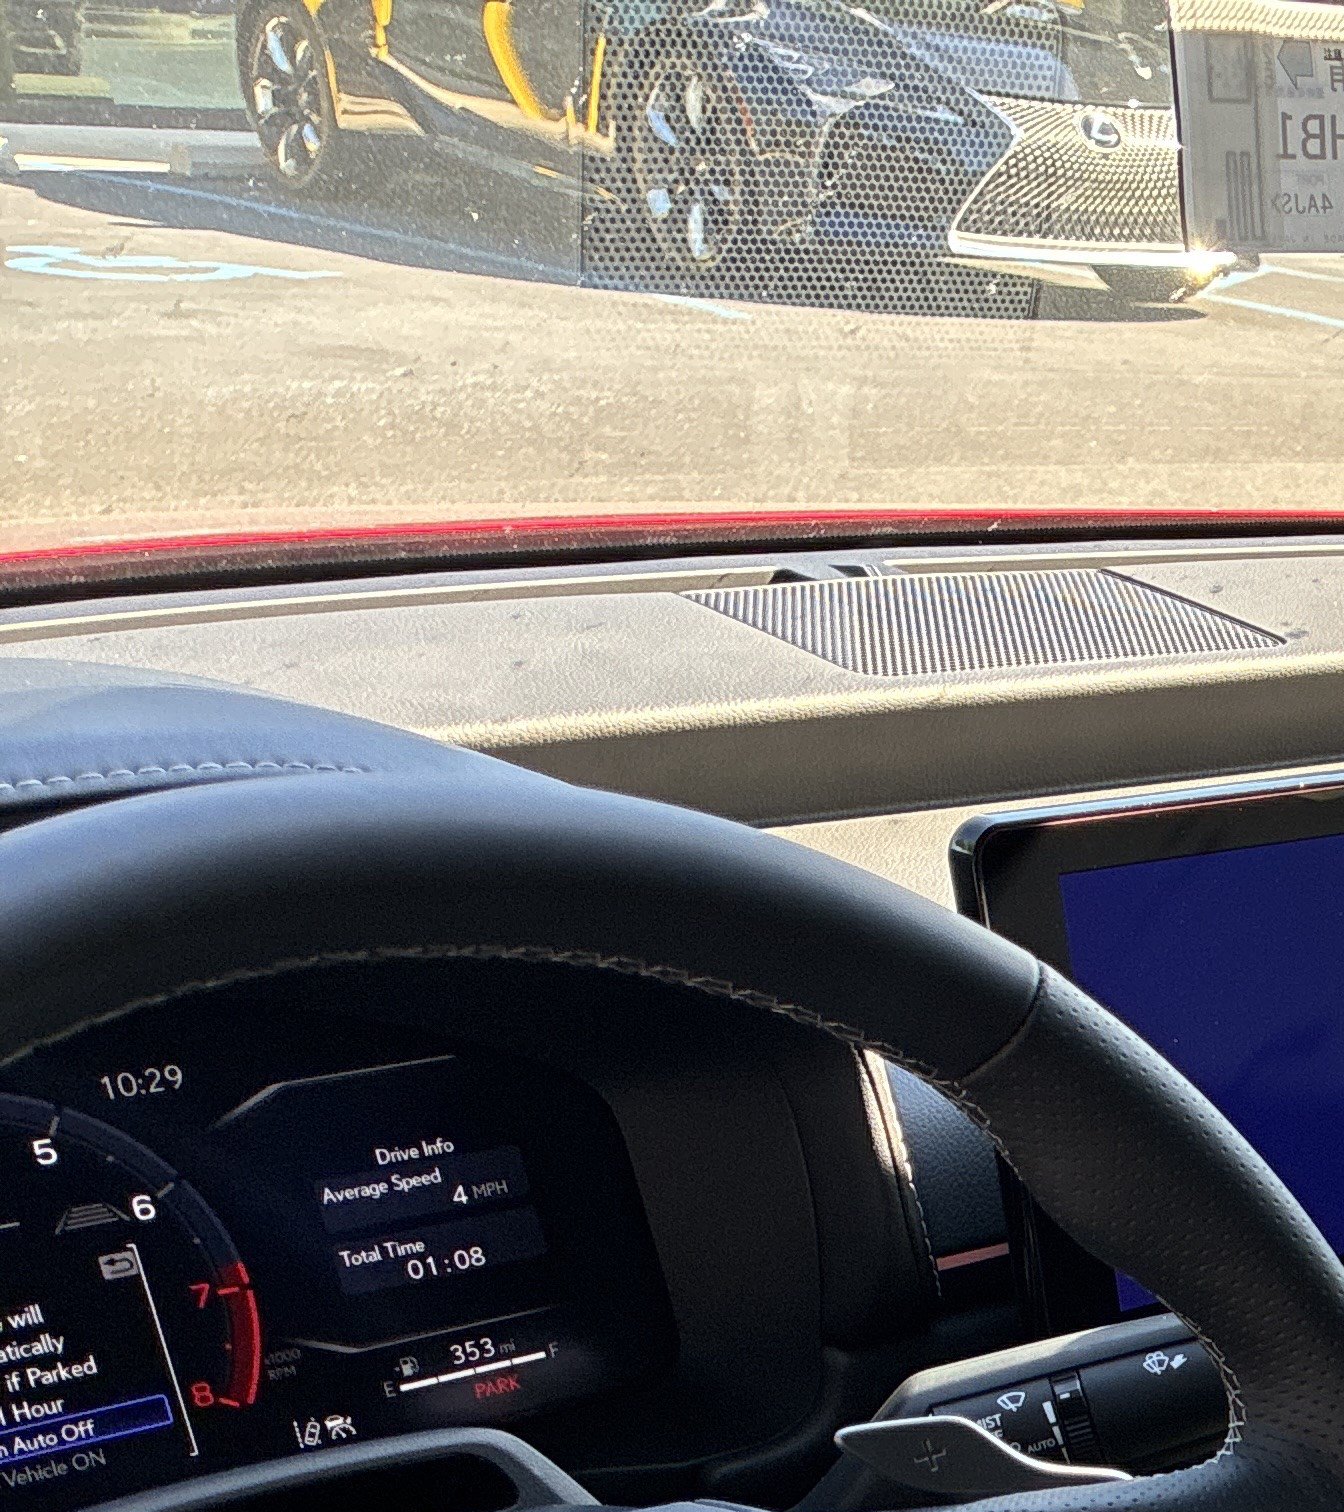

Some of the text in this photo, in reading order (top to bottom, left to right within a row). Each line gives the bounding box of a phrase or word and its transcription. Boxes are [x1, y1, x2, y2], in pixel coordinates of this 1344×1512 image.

[101, 1064, 184, 1099] 10:29
[32, 1139, 58, 1165] 5
[375, 1137, 455, 1166] Drive Info
[322, 1167, 442, 1205] Average Speed
[452, 1179, 510, 1205] 4 MPH
[130, 1194, 156, 1220] 6
[339, 1239, 426, 1268] Total Time
[406, 1247, 487, 1280] 01:08
[189, 1283, 210, 1309] 7
[8, 1303, 45, 1329] will
[450, 1338, 517, 1366] 353 mi
[548, 1342, 560, 1358] F
[4, 1355, 98, 1393] if Parked
[267, 1365, 297, 1382] RPM
[190, 1381, 216, 1408] 8
[384, 1379, 398, 1398] E
[474, 1375, 521, 1399] PARK
[12, 1398, 65, 1424] Hour
[14, 1432, 58, 1456] Auto
[61, 1419, 96, 1441] Off
[1027, 1437, 1056, 1454] AUTO
[2, 1448, 107, 1488] Vehicle ON
